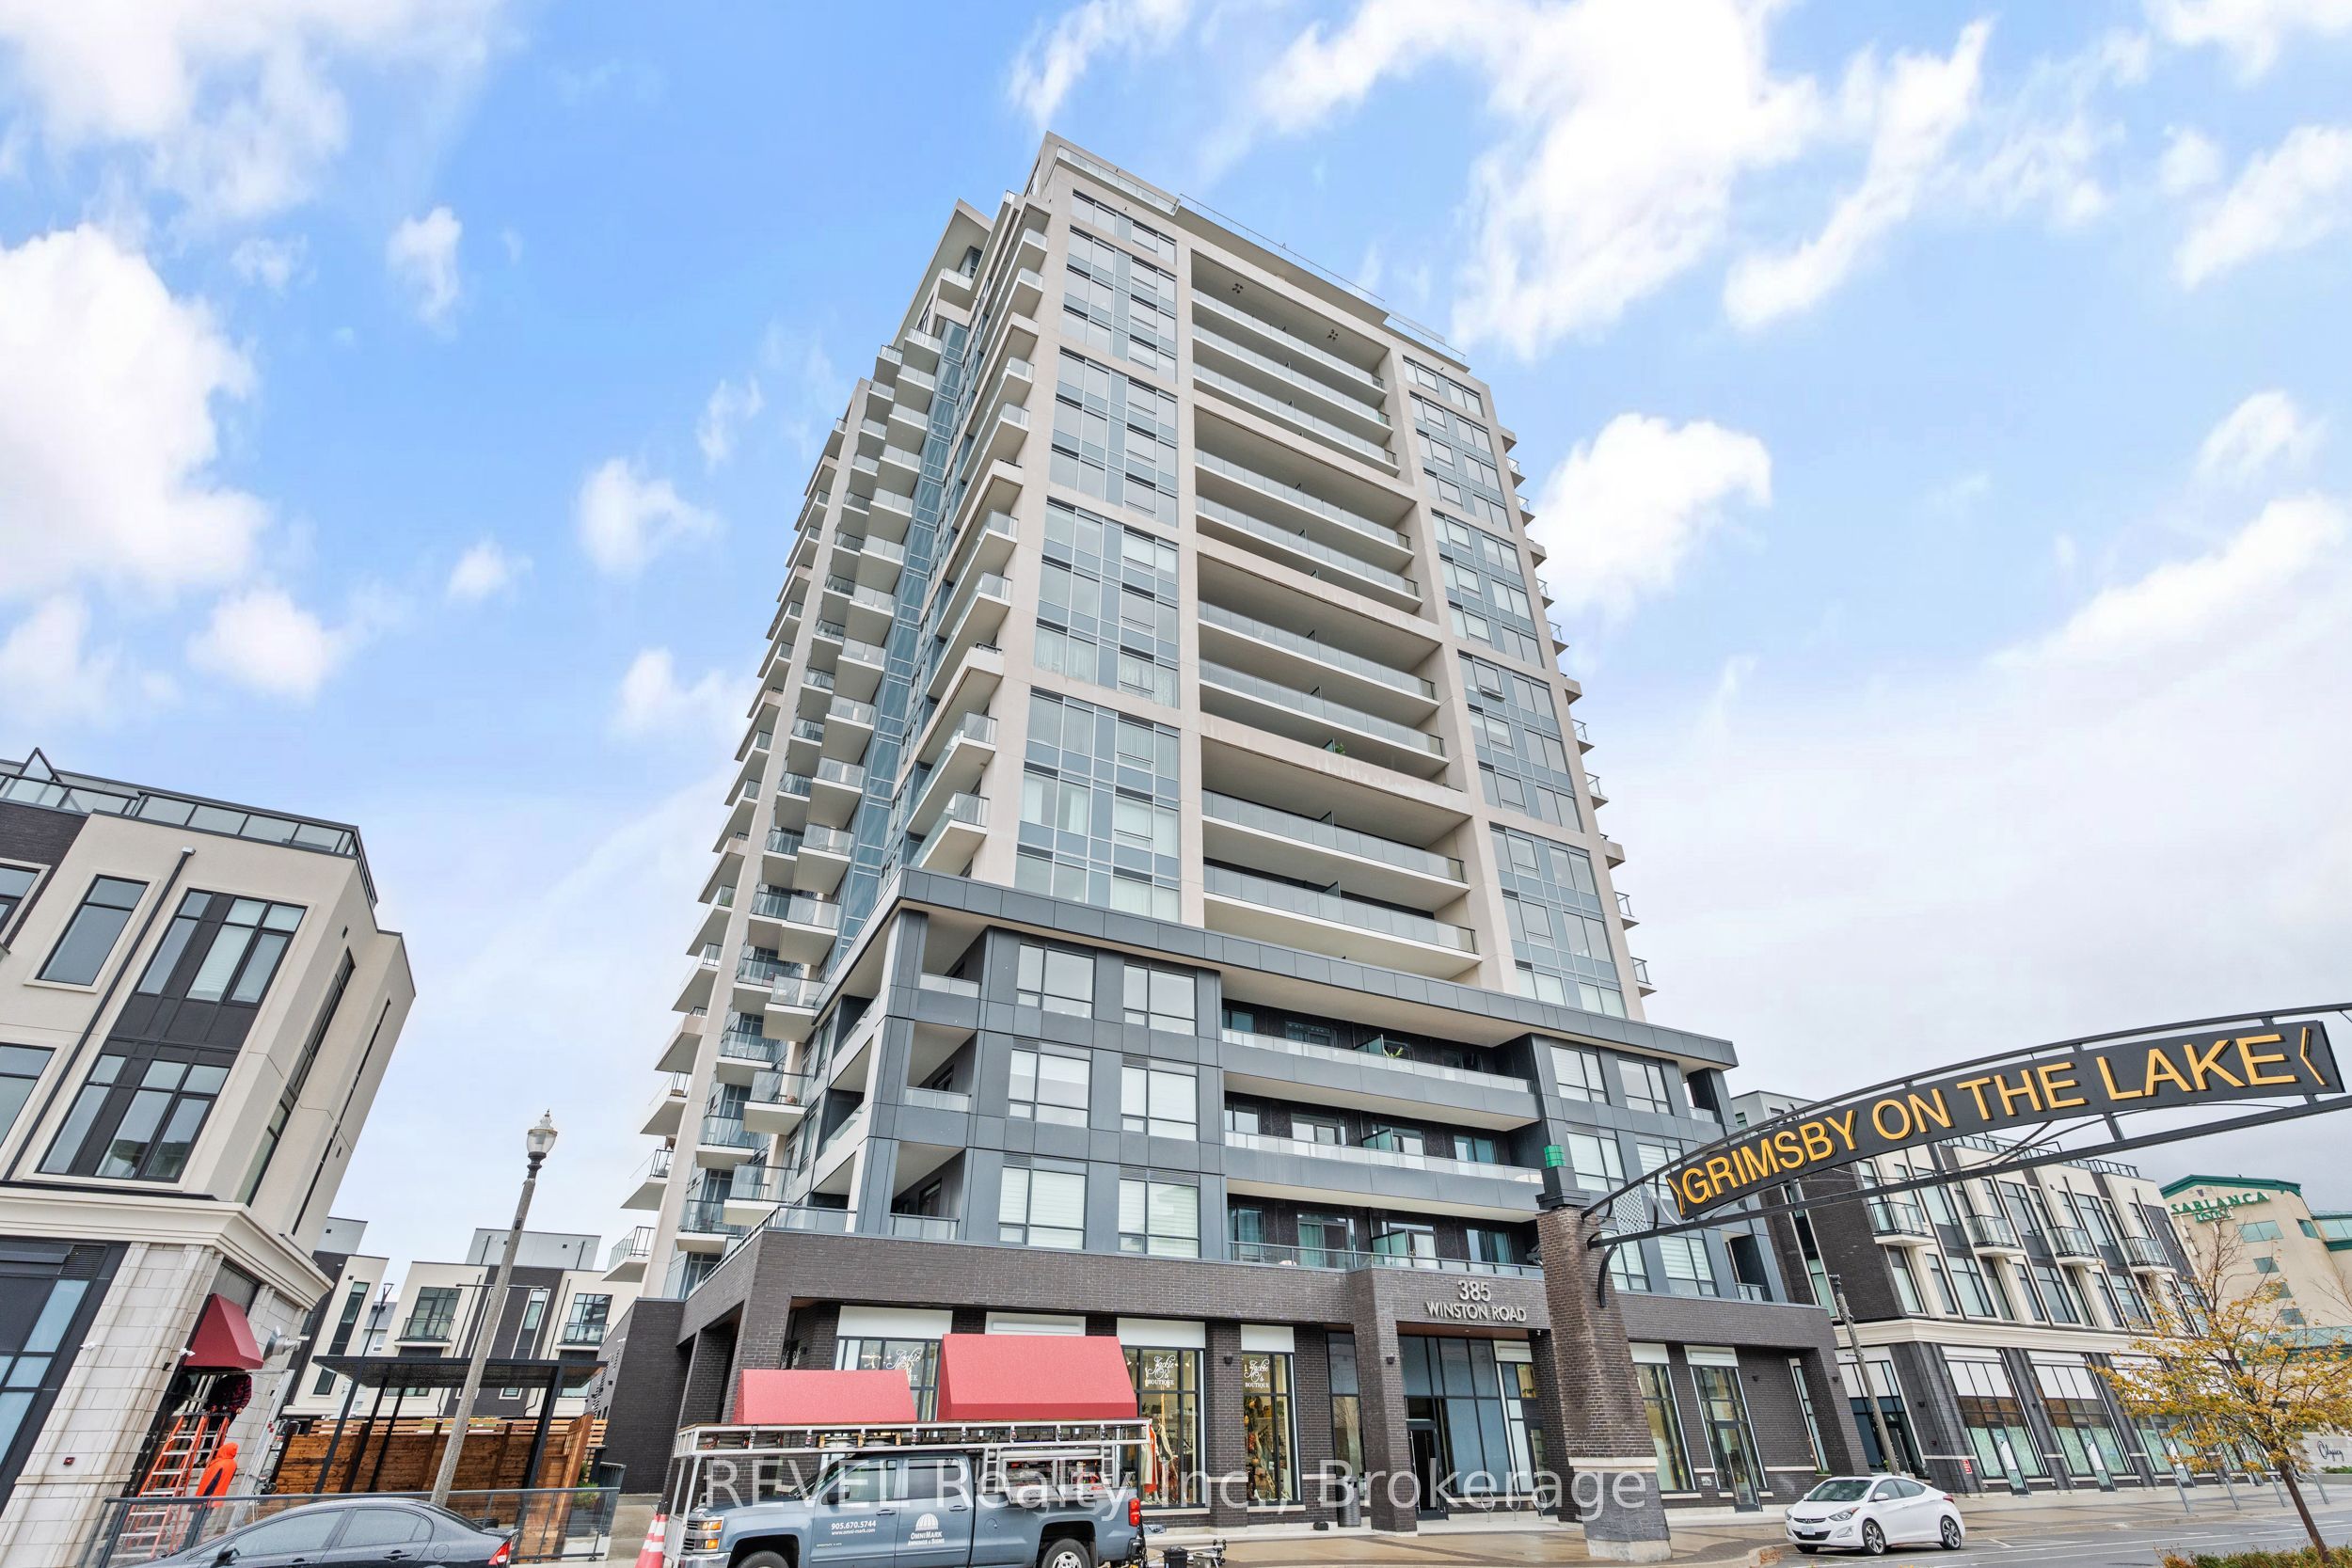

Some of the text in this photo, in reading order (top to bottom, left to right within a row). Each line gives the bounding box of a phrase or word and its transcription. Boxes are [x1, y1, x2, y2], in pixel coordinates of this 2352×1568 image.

[1681, 1033, 2298, 1205] GRIMSBY ON THE LAKE
[2169, 1191, 2271, 1215] SABLANCA
[1458, 1279, 1492, 1302] 385
[1426, 1301, 1527, 1323] WINSTON ROAD
[831, 1520, 877, 1530] 905.670.5744
